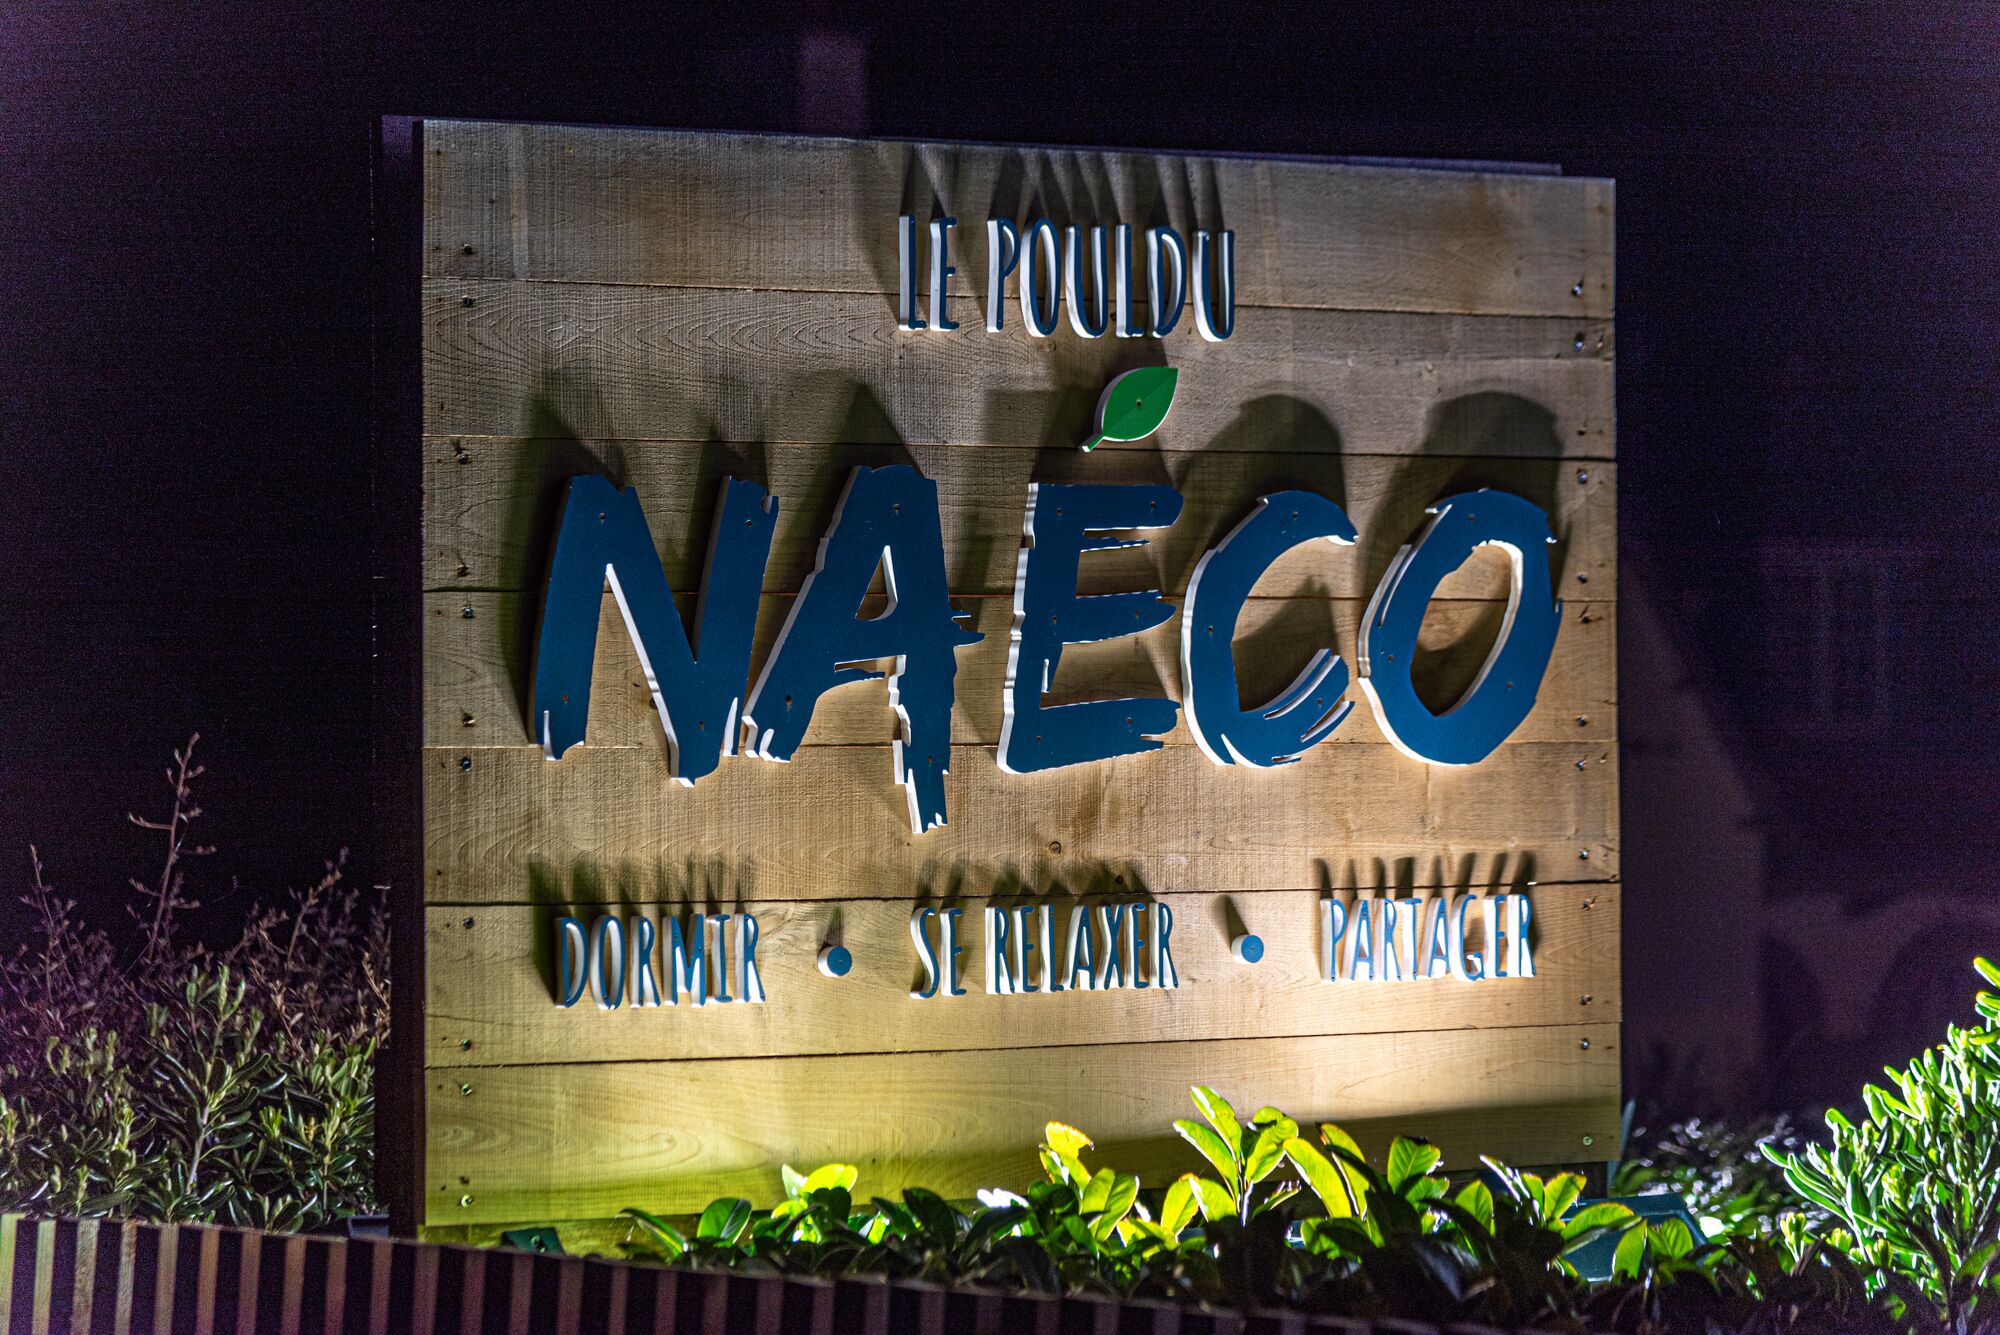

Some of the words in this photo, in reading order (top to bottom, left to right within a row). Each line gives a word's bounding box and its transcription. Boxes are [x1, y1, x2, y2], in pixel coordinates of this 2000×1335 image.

[899, 214, 960, 331] LE
[986, 216, 1235, 342] POULDU
[555, 913, 766, 1010] DORMIR
[910, 906, 967, 999] SE
[984, 902, 1178, 996] RELAXER
[1319, 894, 1536, 982] PARTAGER
